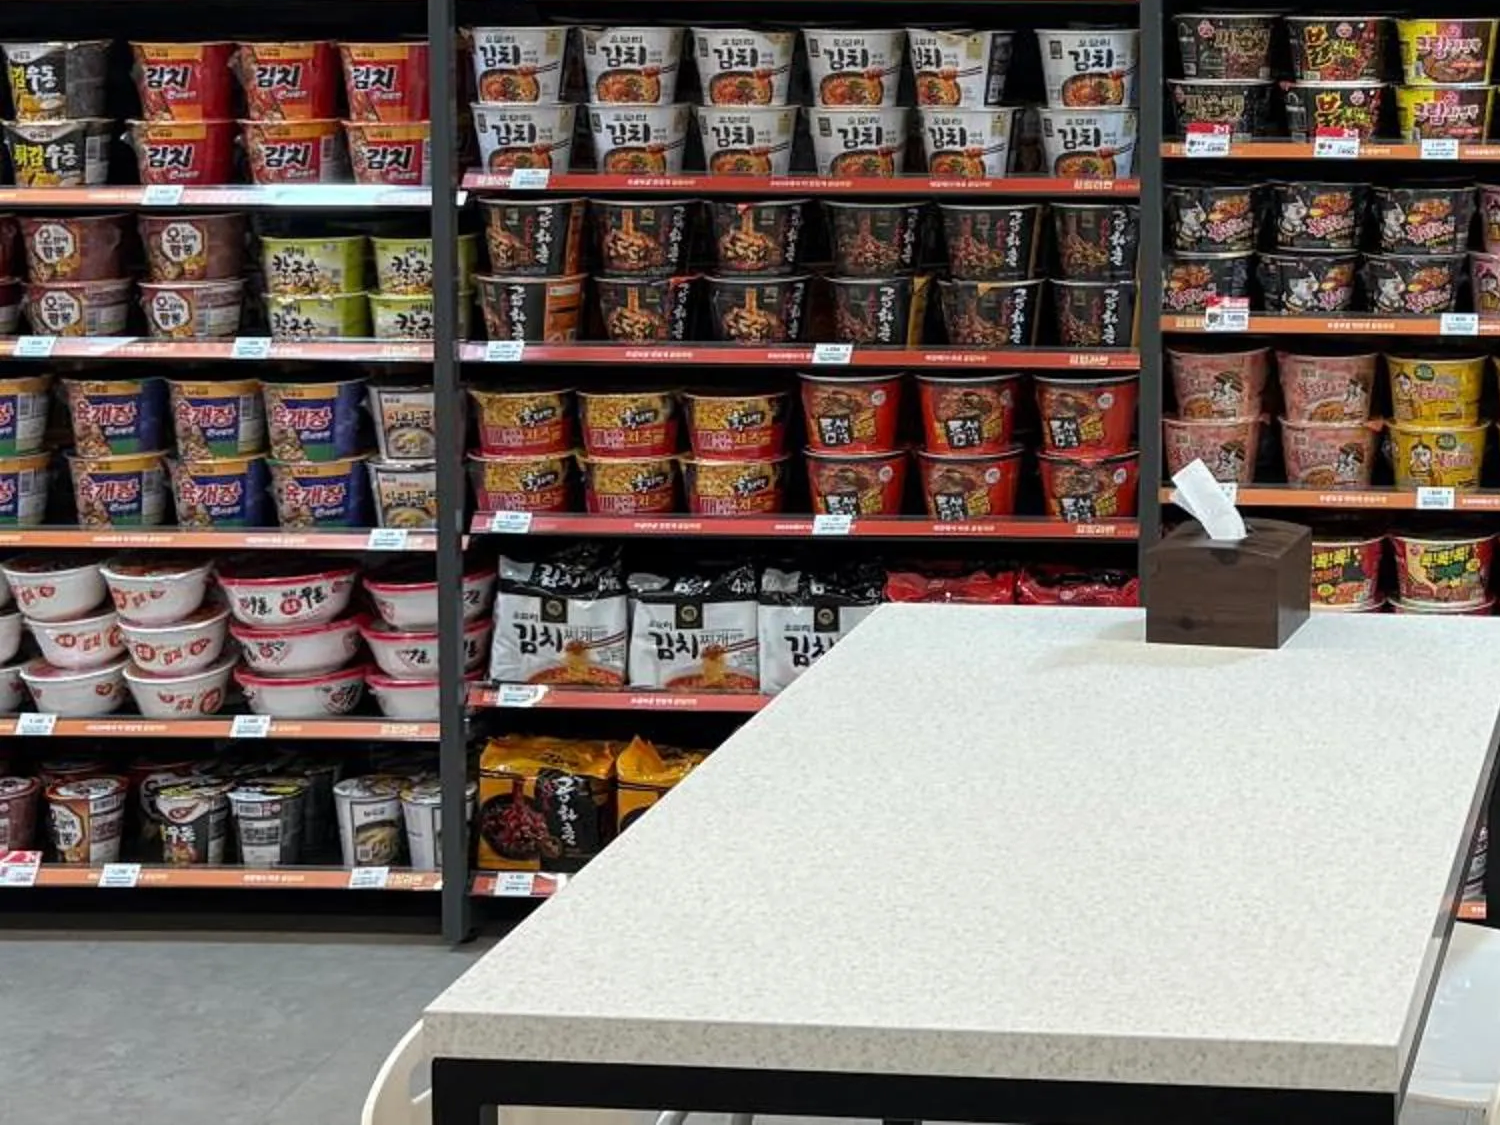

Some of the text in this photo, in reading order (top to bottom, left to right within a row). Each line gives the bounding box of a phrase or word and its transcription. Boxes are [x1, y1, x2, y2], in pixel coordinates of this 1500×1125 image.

[479, 45, 521, 67] 김치
[601, 45, 647, 67] 김치
[714, 47, 758, 69] 김치
[1068, 48, 1114, 69] 김치
[257, 64, 301, 89] 김치
[353, 64, 395, 89] 김치
[491, 124, 537, 144] 김치
[606, 123, 650, 144] 김치
[712, 125, 755, 147] 김치
[928, 127, 967, 149] 김치
[148, 145, 193, 169] 김치
[265, 143, 311, 169] 김치
[366, 145, 412, 170] 김치
[514, 623, 564, 654] 김치
[649, 631, 699, 661] 김치
